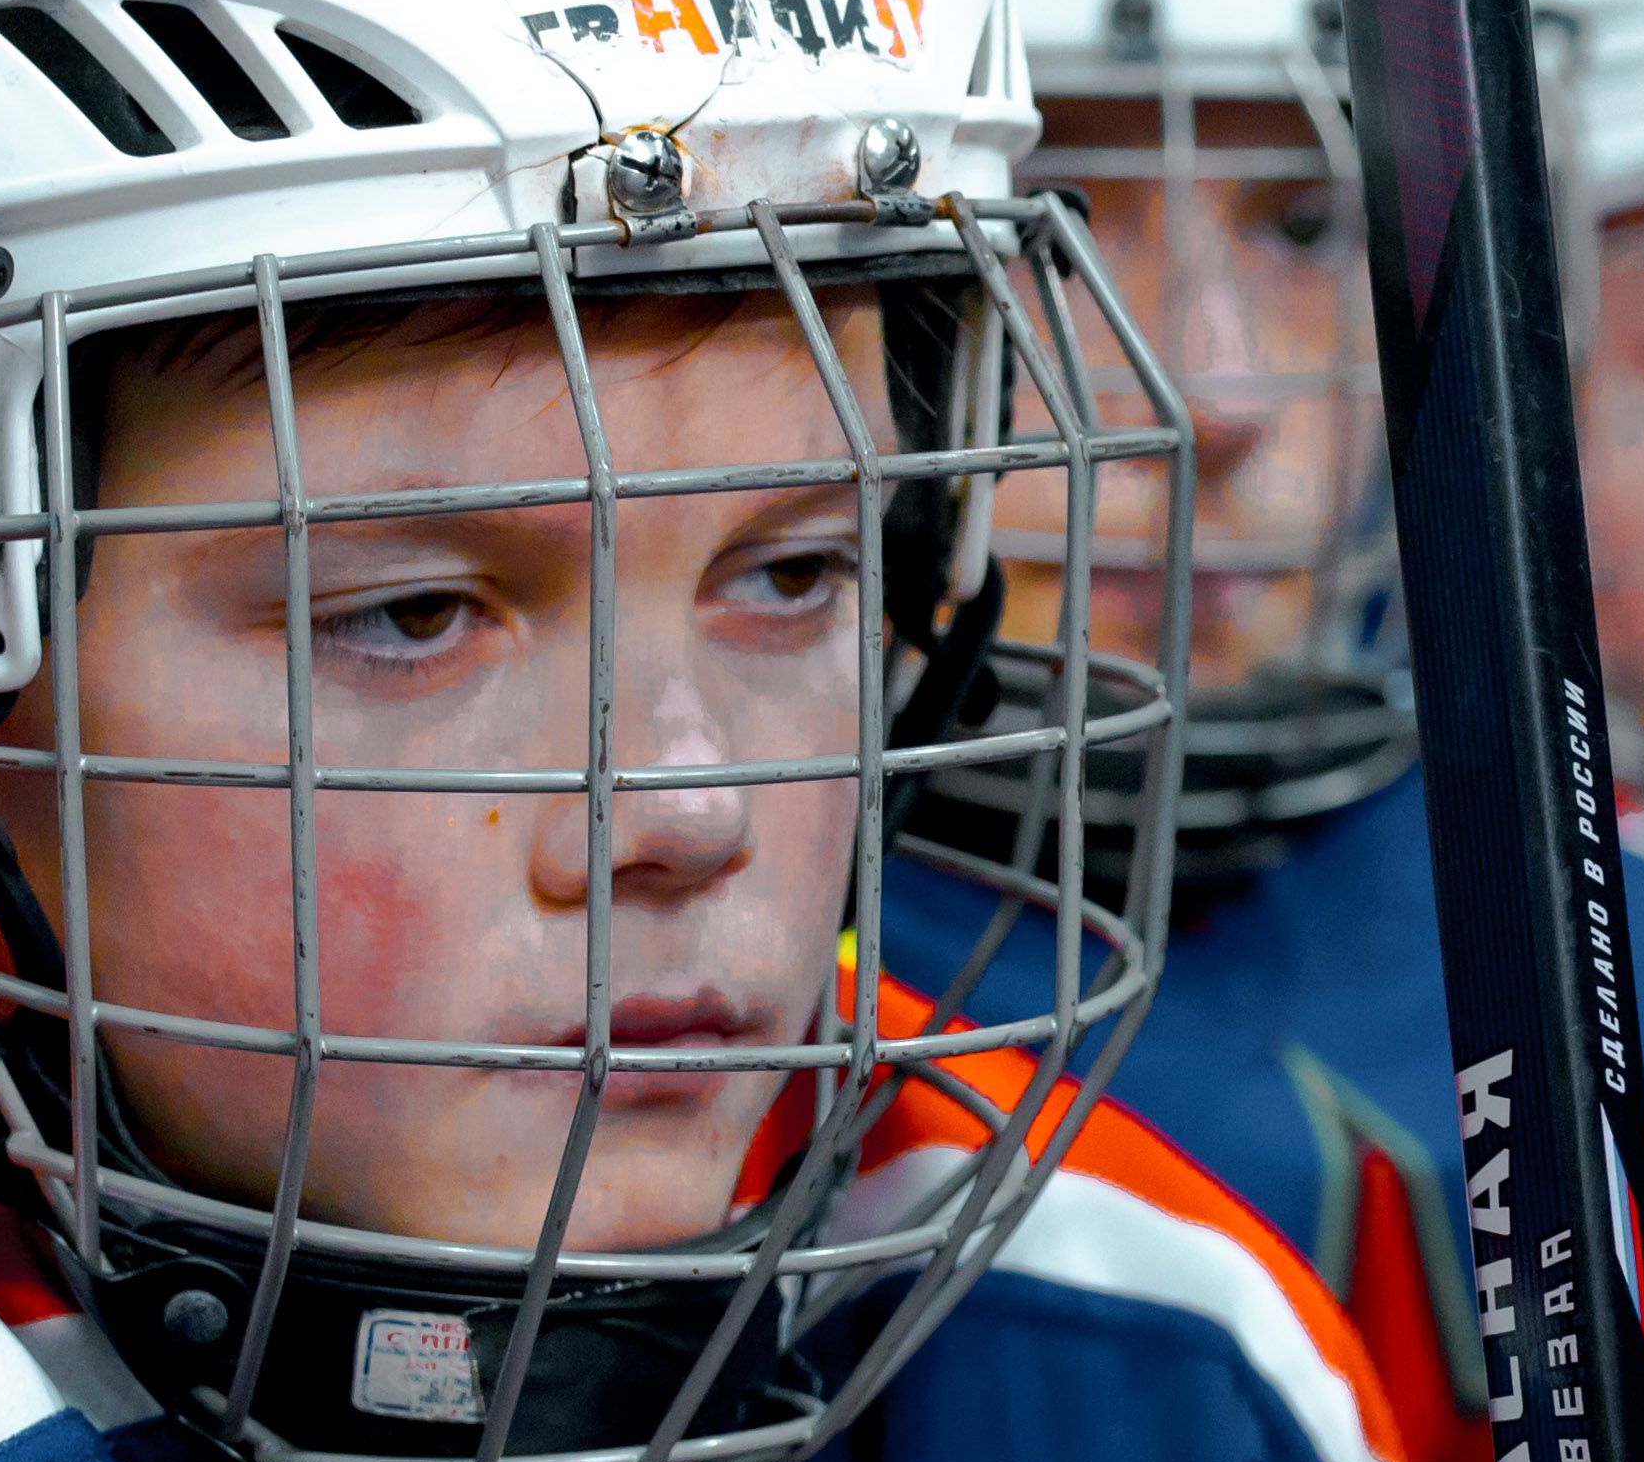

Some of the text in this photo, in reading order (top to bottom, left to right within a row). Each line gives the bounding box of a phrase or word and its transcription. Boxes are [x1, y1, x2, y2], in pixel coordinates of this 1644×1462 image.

[1563, 677, 1626, 1095] СДЕЛАНО В РОССИИ
